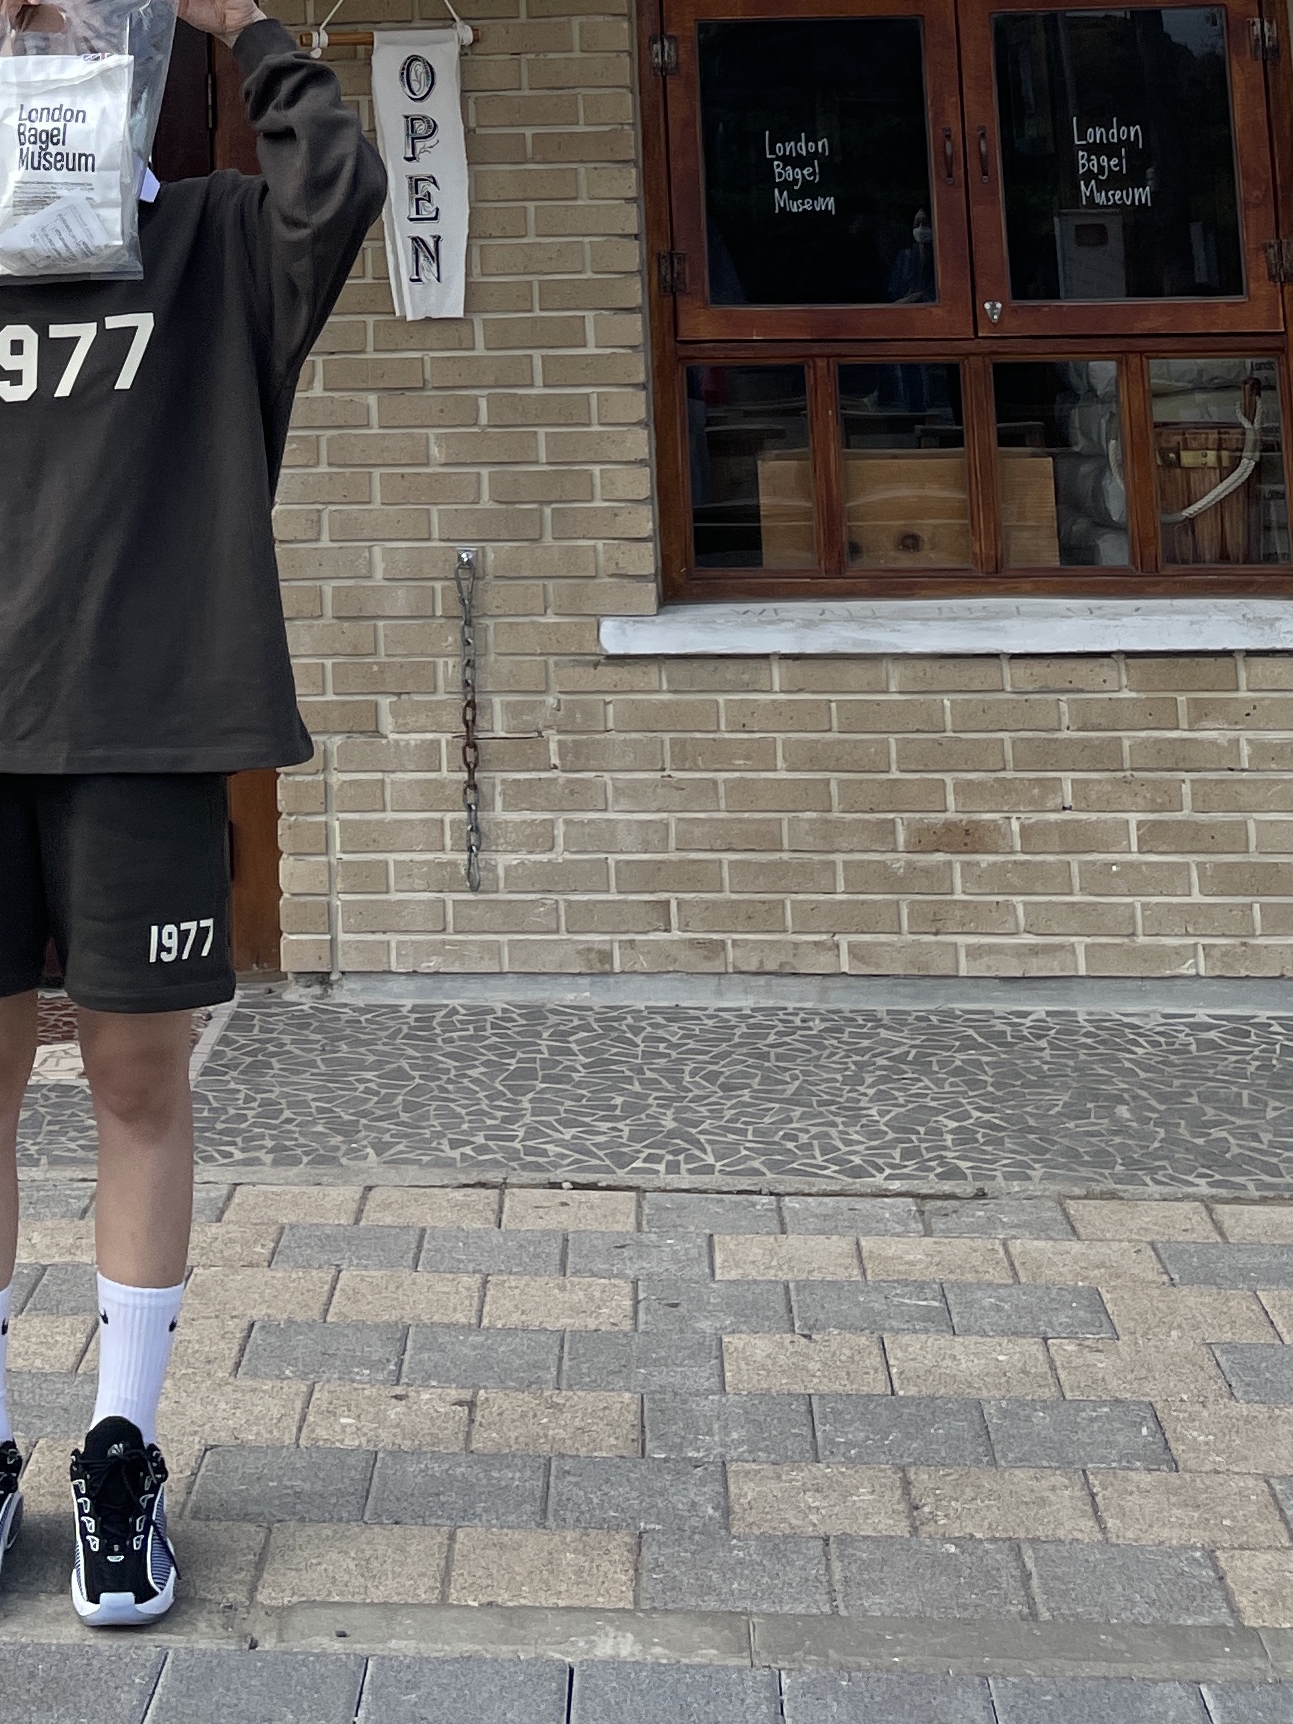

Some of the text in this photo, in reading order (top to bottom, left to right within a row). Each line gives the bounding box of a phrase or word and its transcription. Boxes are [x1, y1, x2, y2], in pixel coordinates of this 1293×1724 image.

[18, 104, 87, 124] London
[17, 123, 67, 151] Bagel
[765, 130, 829, 159] London
[1073, 117, 1142, 149] London
[18, 146, 96, 172] Museum
[399, 53, 443, 286] OPEN
[1078, 147, 1126, 180] Bagel
[773, 159, 820, 190] Bagel
[774, 187, 835, 216] Museum
[1080, 179, 1151, 207] Museum
[149, 917, 214, 963] 1977
